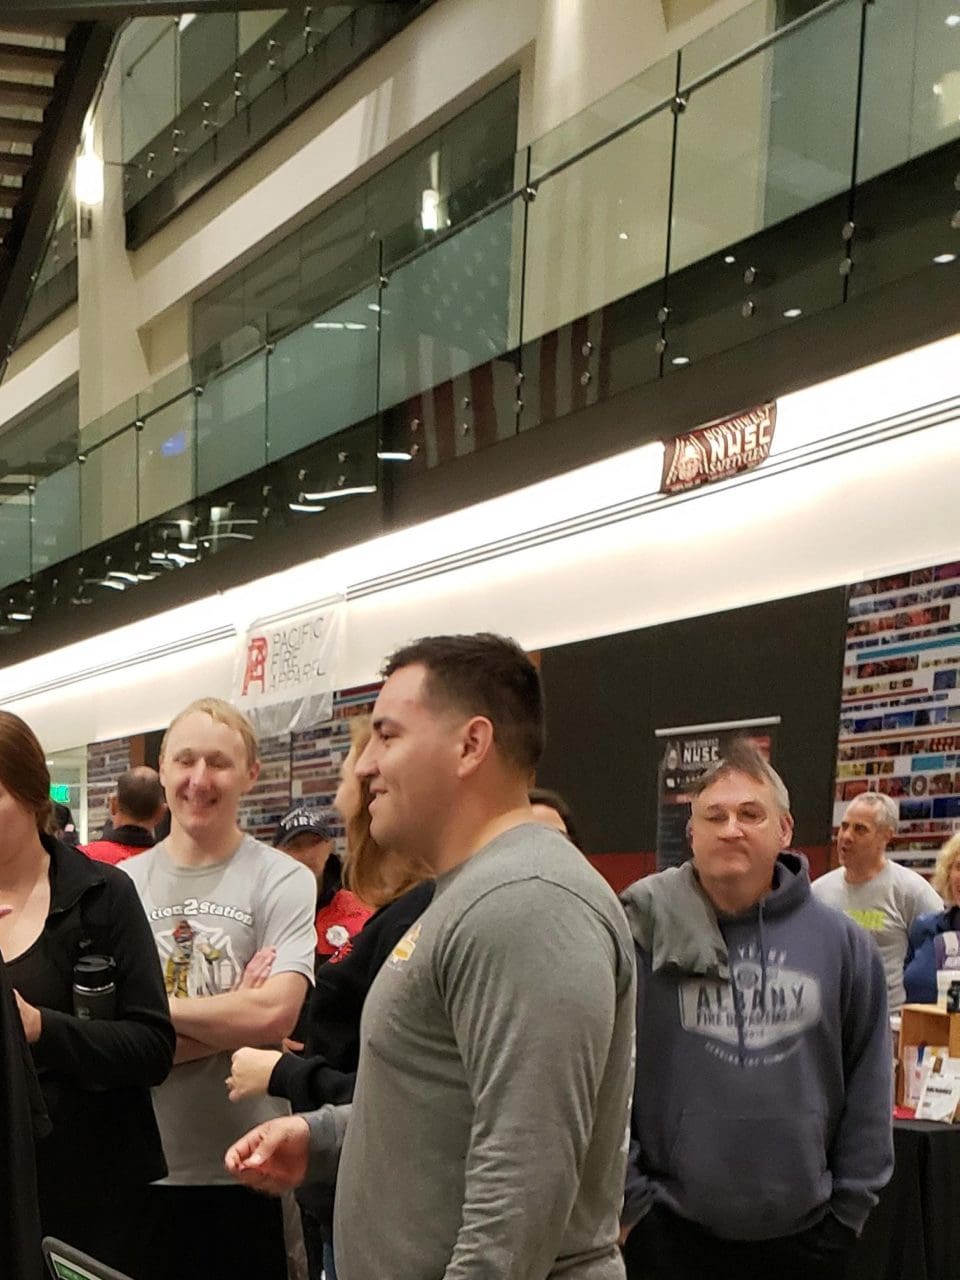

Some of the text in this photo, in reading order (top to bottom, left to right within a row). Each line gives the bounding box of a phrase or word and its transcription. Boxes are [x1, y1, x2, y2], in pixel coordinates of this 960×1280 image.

[708, 419, 771, 463] NWSC
[683, 746, 720, 763] NWSC
[149, 898, 255, 928] tion2Station
